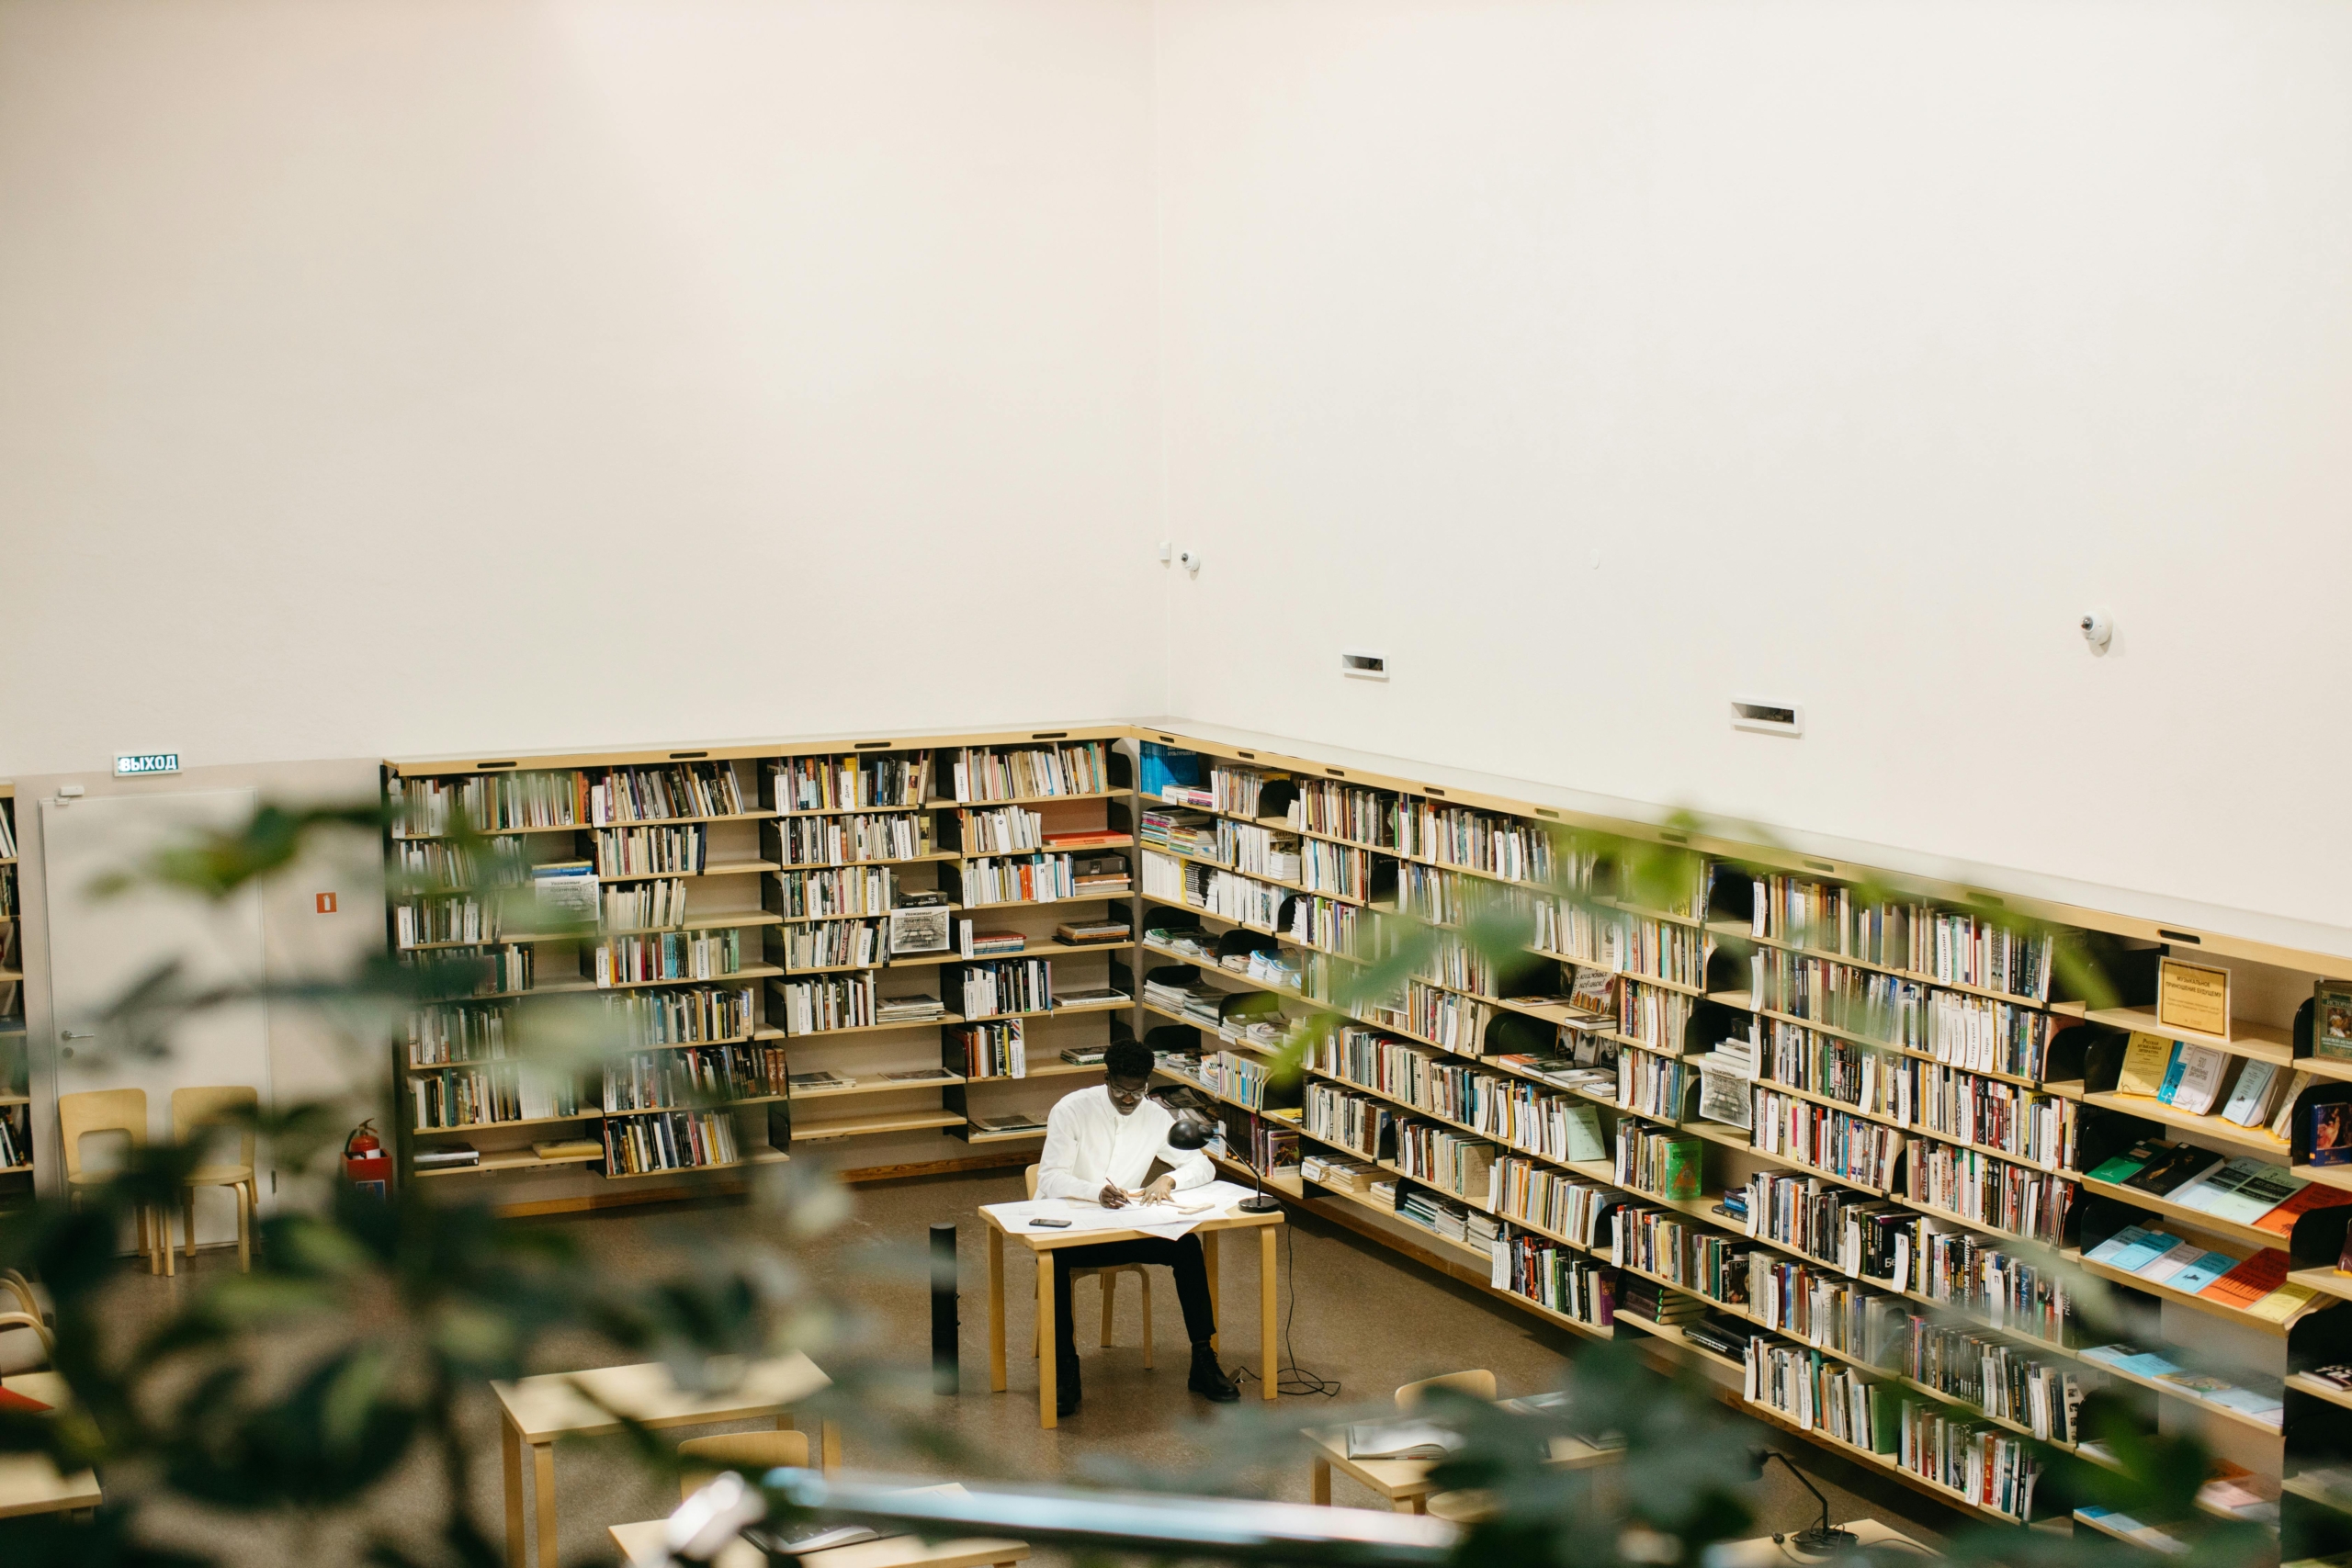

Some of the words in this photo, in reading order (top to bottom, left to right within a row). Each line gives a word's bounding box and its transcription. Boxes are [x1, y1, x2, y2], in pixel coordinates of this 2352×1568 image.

[120, 755, 177, 772] ВЫХОД
[2165, 981, 2197, 993] ПРИНОШЕНИЕ
[2196, 987, 2222, 998] БУДУЩЕМУ
[2177, 976, 2211, 987] МУЗЫКАЛЬНОЕ
